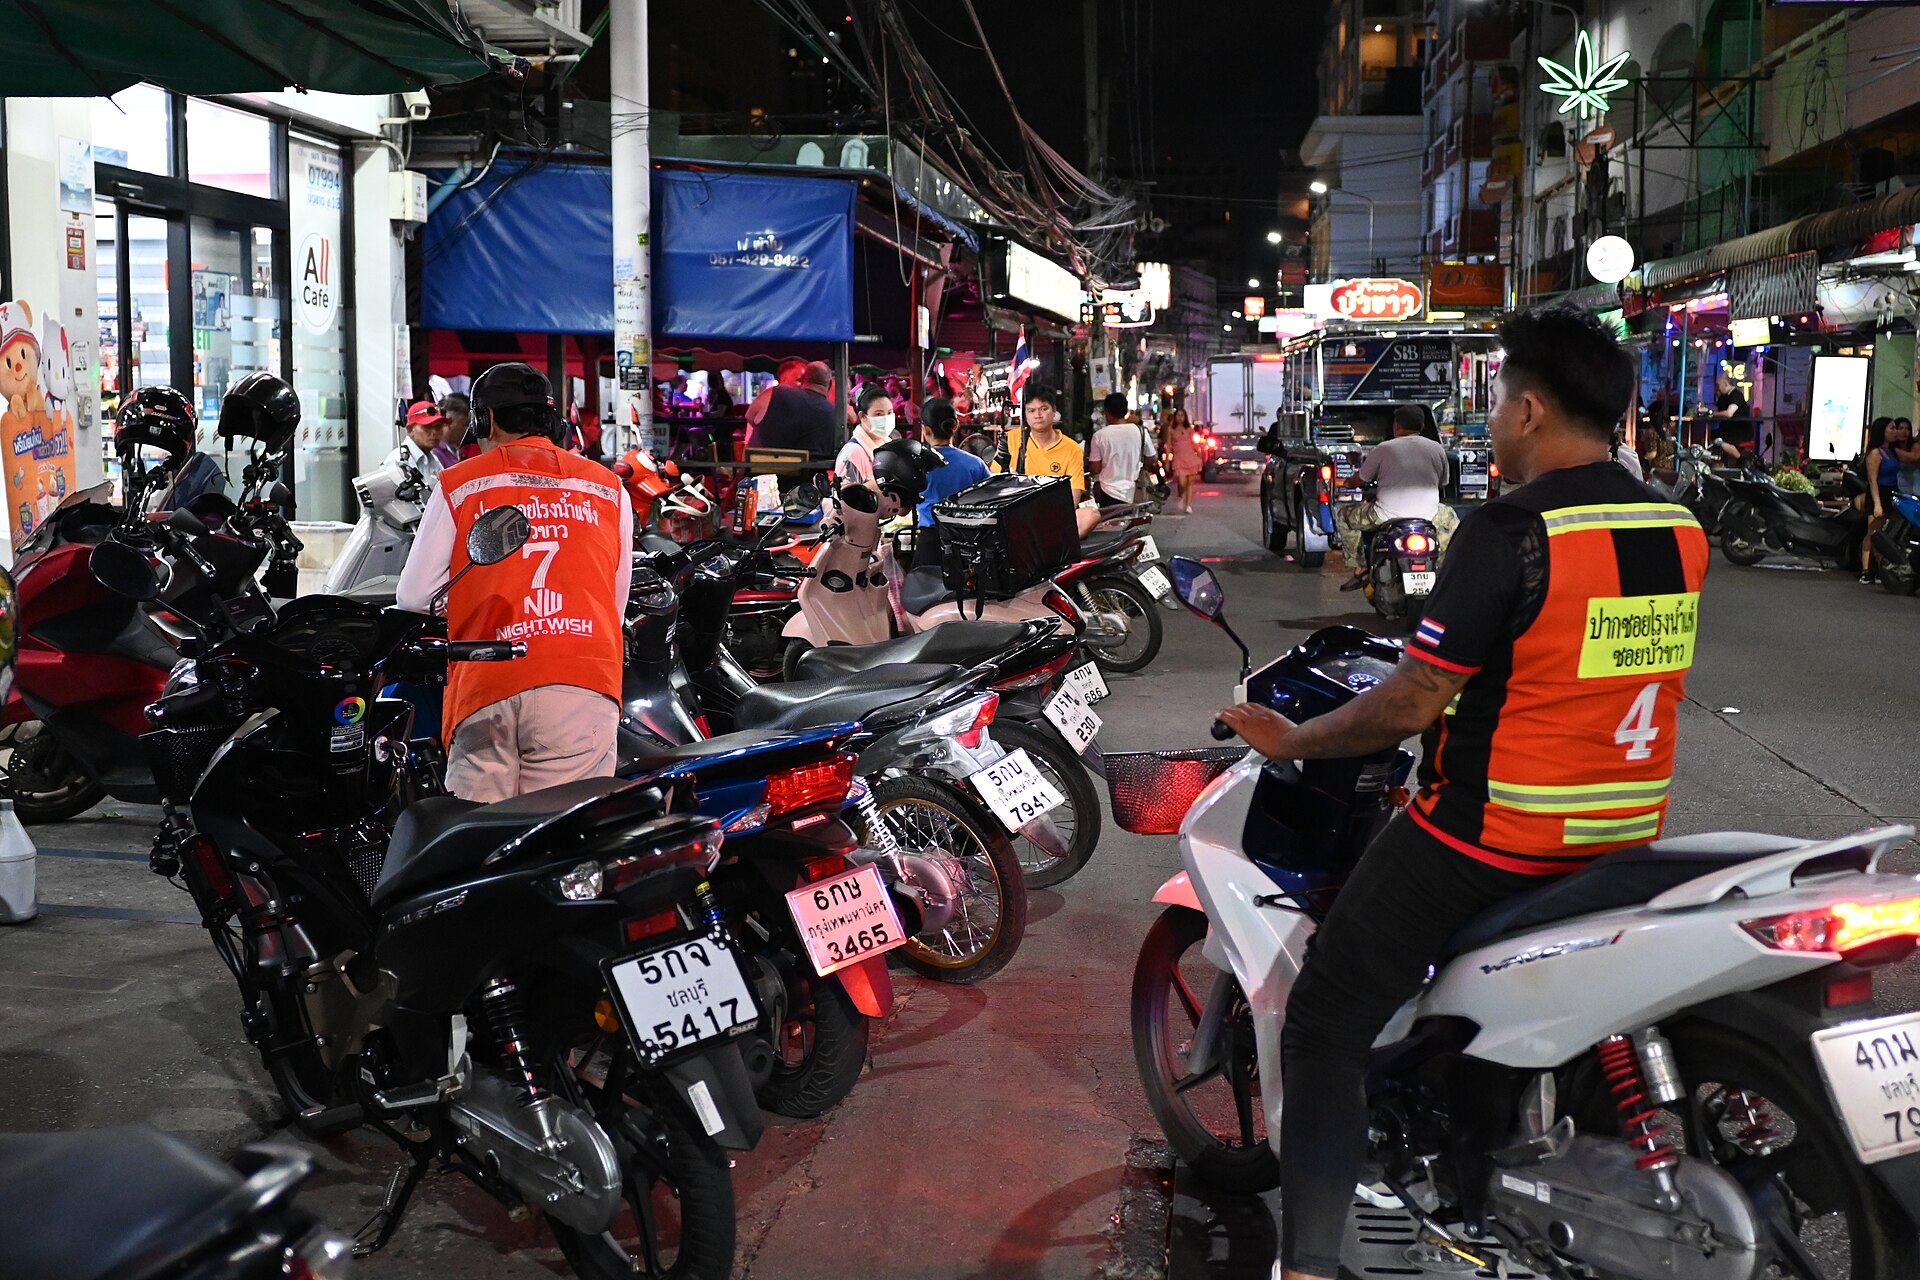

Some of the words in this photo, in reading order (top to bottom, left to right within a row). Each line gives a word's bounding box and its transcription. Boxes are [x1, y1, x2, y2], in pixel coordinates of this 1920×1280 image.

[303, 237, 329, 286] All
[303, 285, 329, 308] Café
[1336, 289, 1415, 315] บัวขาว
[522, 541, 560, 589] 7
[525, 629, 566, 639] GROUP
[1613, 637, 1685, 667] ซอยบัวขาว
[1084, 687, 1103, 703] 686
[1075, 715, 1096, 742] 230
[1614, 681, 1661, 761] 4
[987, 759, 1023, 787] 5กบ
[793, 814, 827, 829] HONDA
[1009, 791, 1053, 823] 7941
[813, 877, 862, 910] 6กษ
[808, 899, 887, 939] กรุงเทพมหานคร
[827, 923, 889, 962] 3465
[637, 942, 711, 985] 5กจ
[667, 978, 709, 1007] ชลบุรี
[652, 997, 738, 1051] 5417
[1881, 1072, 1920, 1101] ชลบุรี
